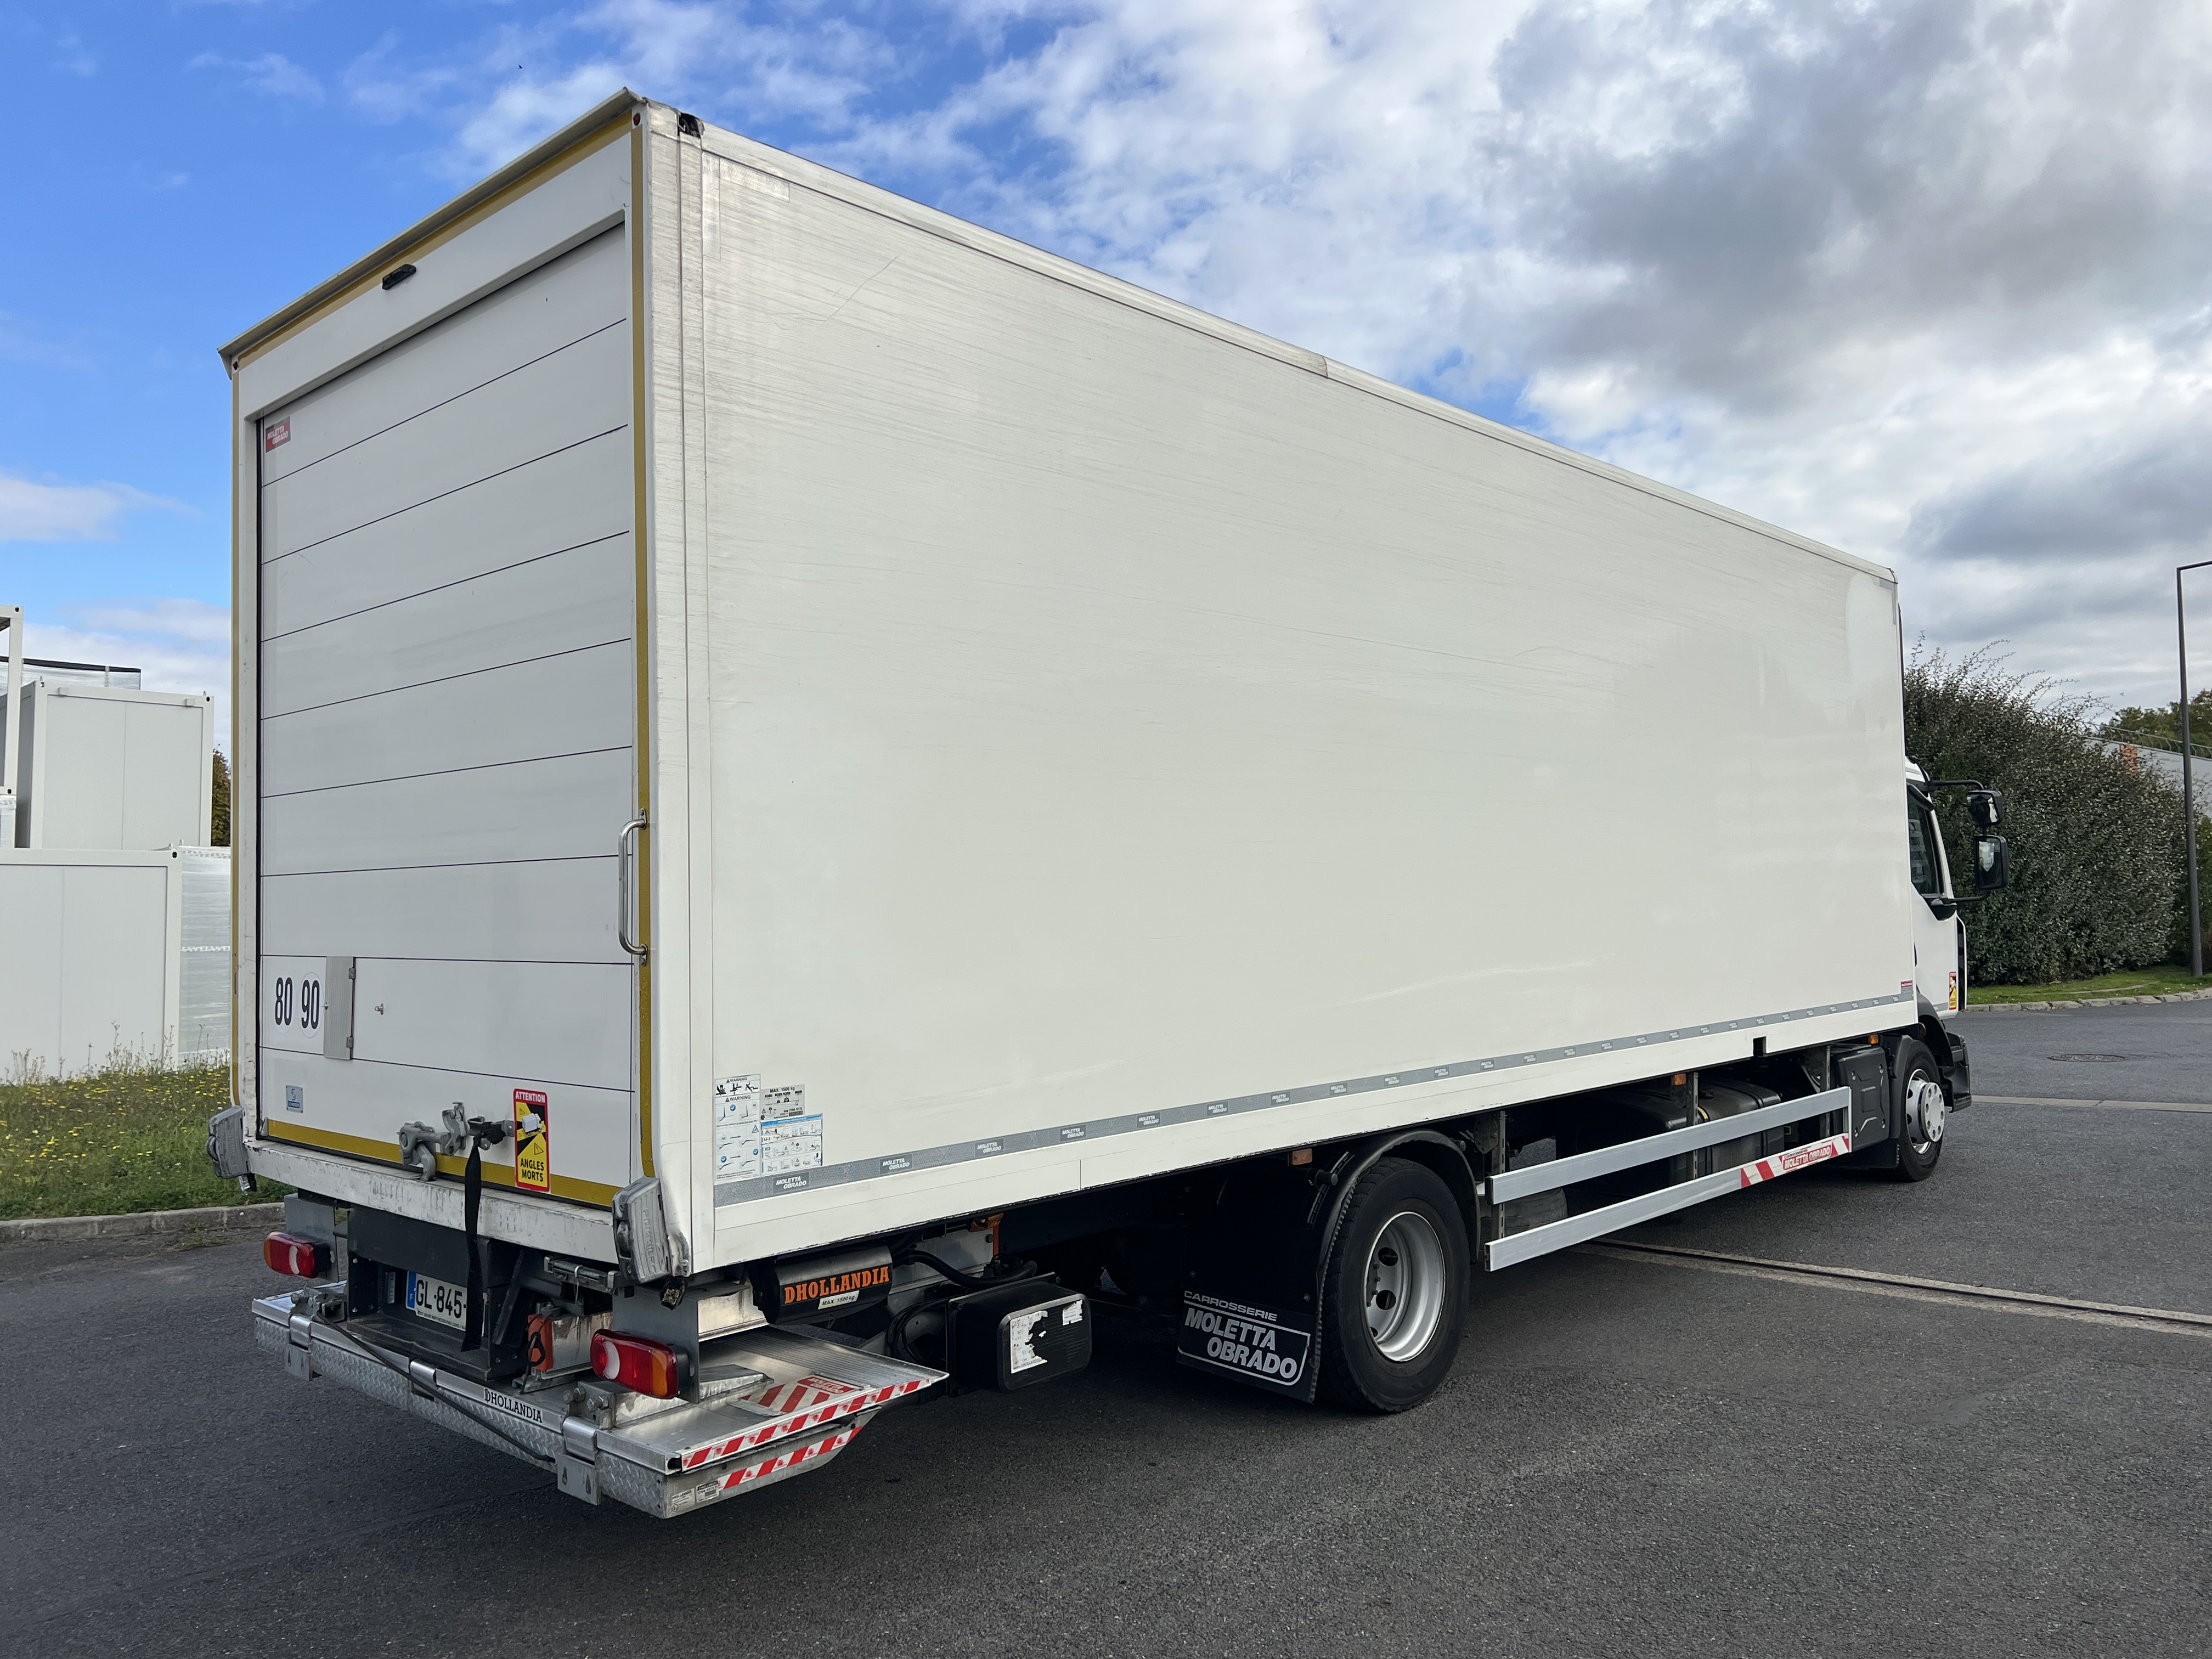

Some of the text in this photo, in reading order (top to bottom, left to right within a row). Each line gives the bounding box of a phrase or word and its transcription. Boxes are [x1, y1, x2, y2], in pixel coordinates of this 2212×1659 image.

[275, 977, 320, 1029] 80 90
[515, 1091, 545, 1103] ATTENTION
[977, 1142, 997, 1150] MOLETTA
[520, 1158, 545, 1171] ANGLES
[882, 1158, 905, 1166] MOLETTA
[1784, 1146, 1831, 1170] MOLETTA OBRADO
[889, 1161, 910, 1170] OBRADO
[522, 1169, 544, 1182] MORTS
[776, 1176, 801, 1186] MOLETTA
[783, 1180, 807, 1189] OBRADO
[784, 1266, 890, 1305] DHOLLANDIA
[1184, 1290, 1278, 1322] CARROSSERIE
[1184, 1307, 1276, 1351] MOLETTA
[1207, 1336, 1297, 1379] OBRADO
[484, 1388, 543, 1423] DHOLLANDIA
